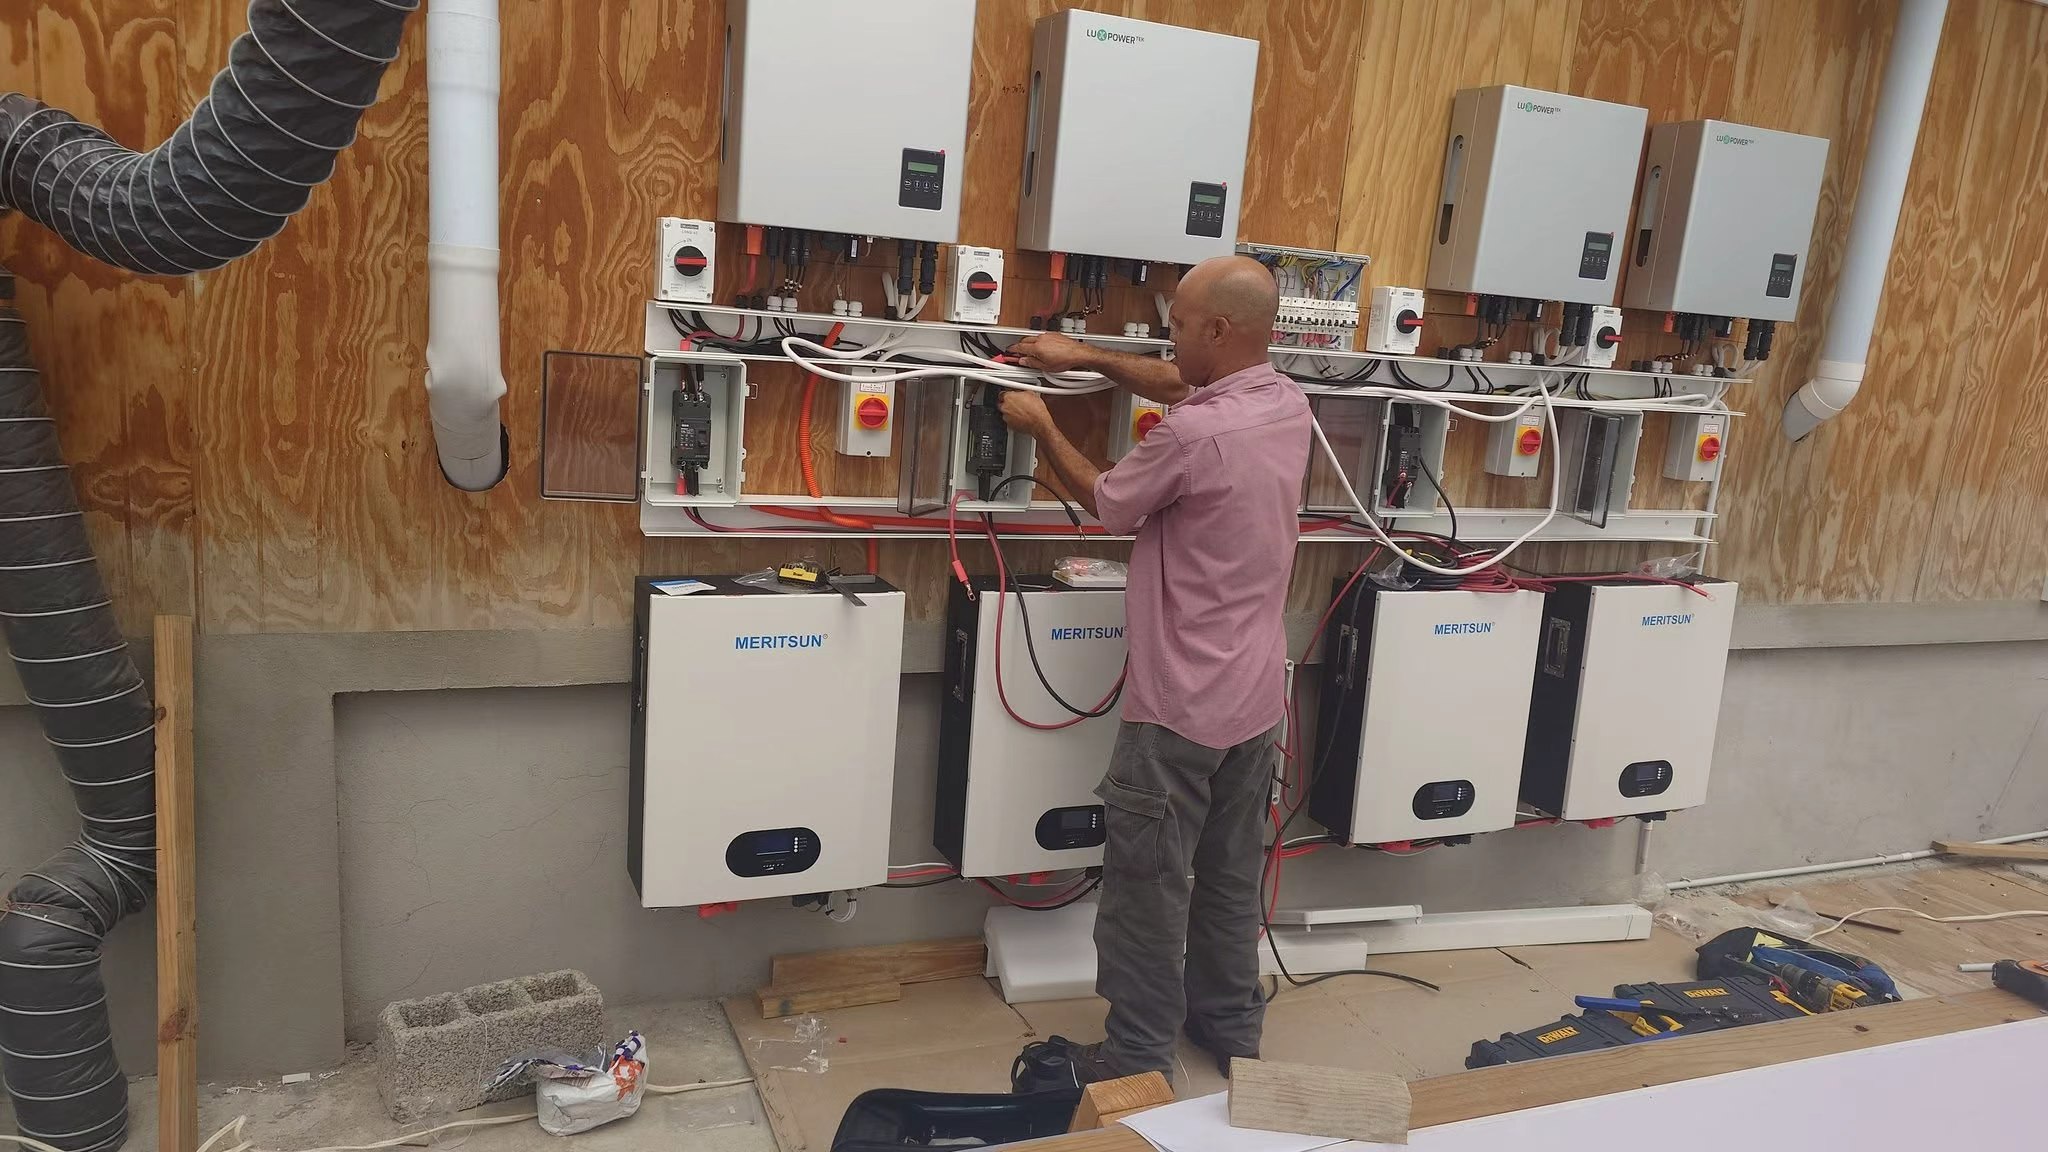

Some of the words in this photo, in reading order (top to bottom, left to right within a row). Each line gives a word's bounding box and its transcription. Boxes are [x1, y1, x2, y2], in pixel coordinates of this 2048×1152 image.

[1642, 614, 1691, 626] MERITSUN
[1051, 626, 1124, 640] MERITSUN
[1434, 622, 1491, 635] MERITSUN
[735, 635, 822, 650] MERITSUN
